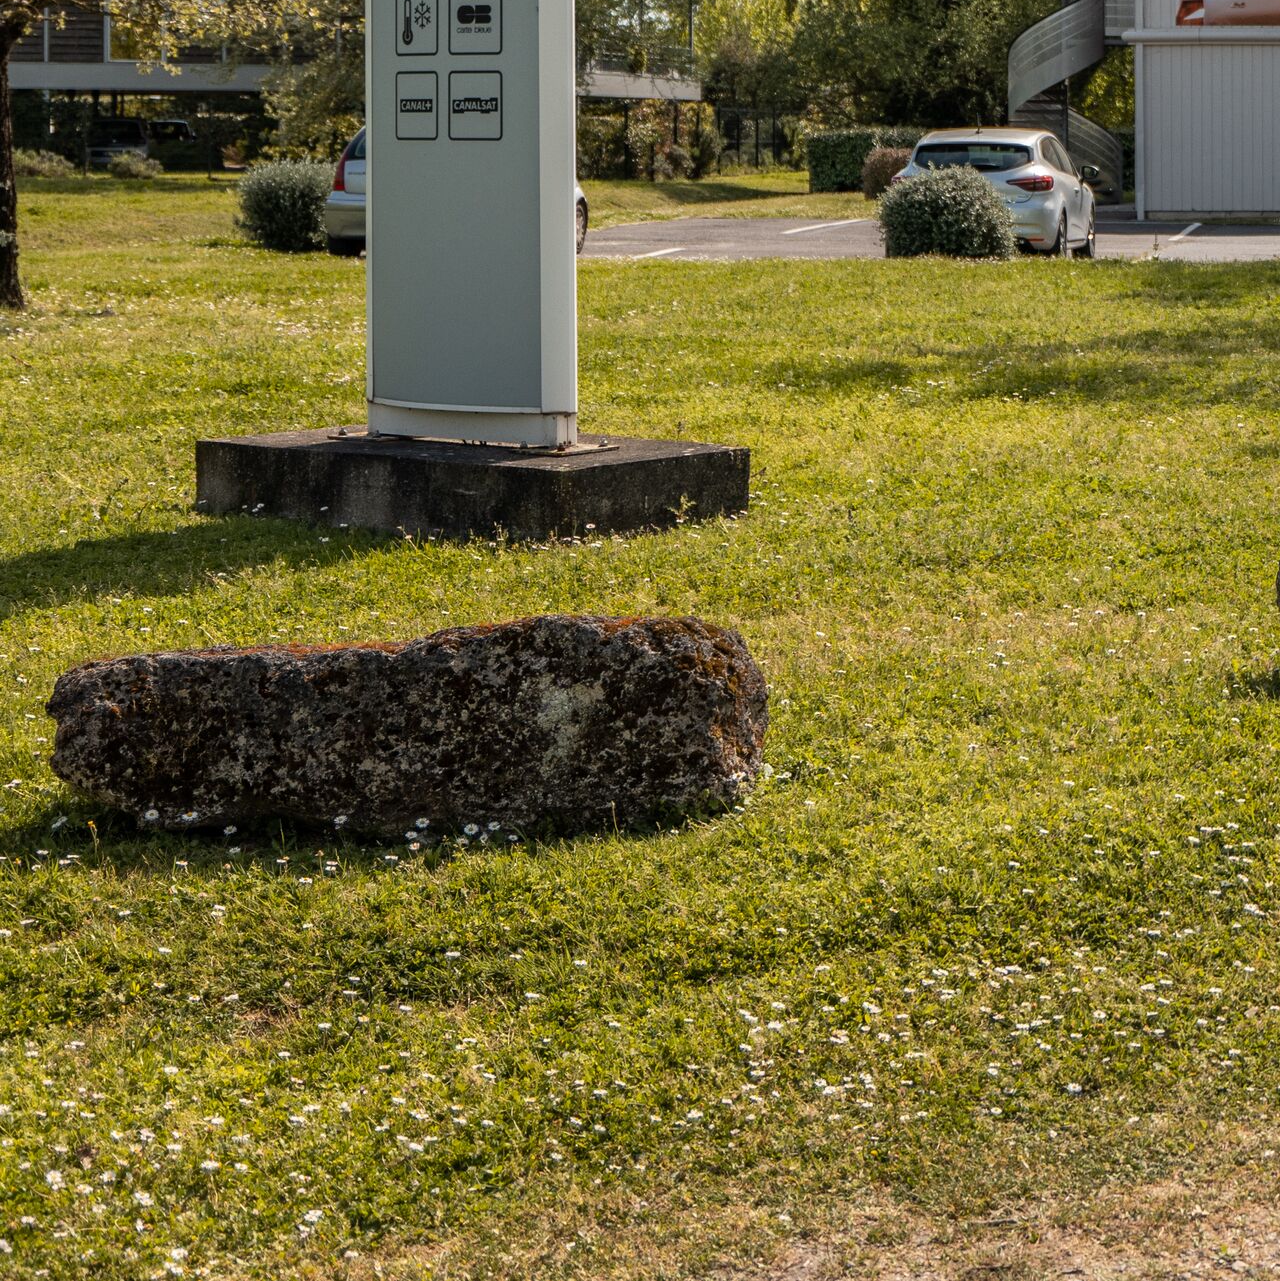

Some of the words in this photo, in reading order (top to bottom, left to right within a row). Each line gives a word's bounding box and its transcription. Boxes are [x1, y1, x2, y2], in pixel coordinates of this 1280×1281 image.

[474, 26, 492, 34] bleue
[401, 100, 432, 111] CANAL+
[454, 100, 497, 111] CANALSAT
